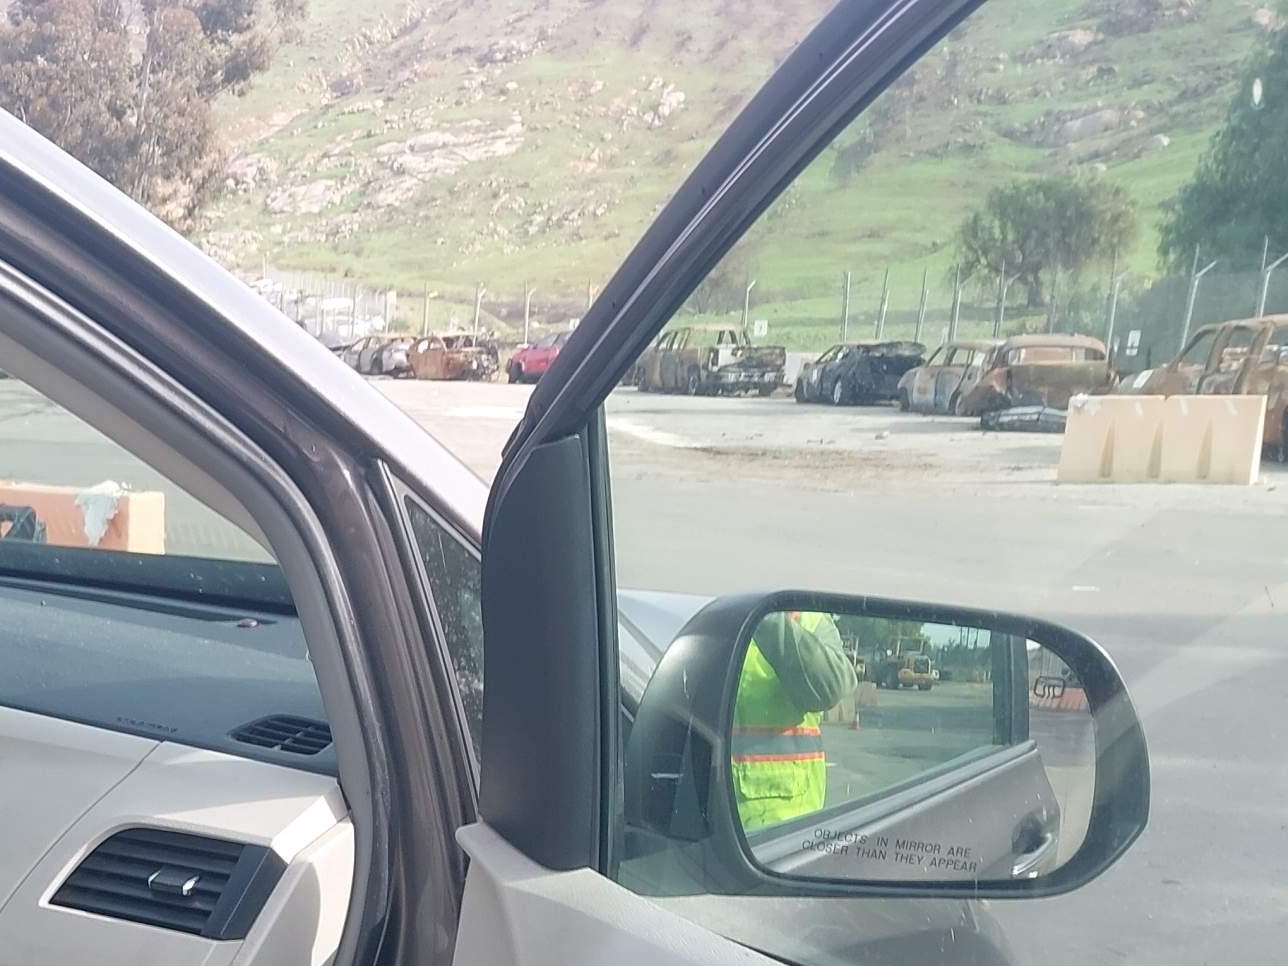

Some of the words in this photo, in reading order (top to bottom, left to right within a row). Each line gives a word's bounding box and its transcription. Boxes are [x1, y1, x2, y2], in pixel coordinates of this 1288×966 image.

[802, 840, 849, 856] CLOSER
[856, 847, 888, 861] THAN
[894, 852, 924, 866] THEY
[929, 857, 978, 873] APPEAR
[814, 828, 867, 845] OBJECTS
[876, 836, 889, 847] IN
[895, 839, 941, 855] MIRROR
[945, 847, 972, 857] ARE
